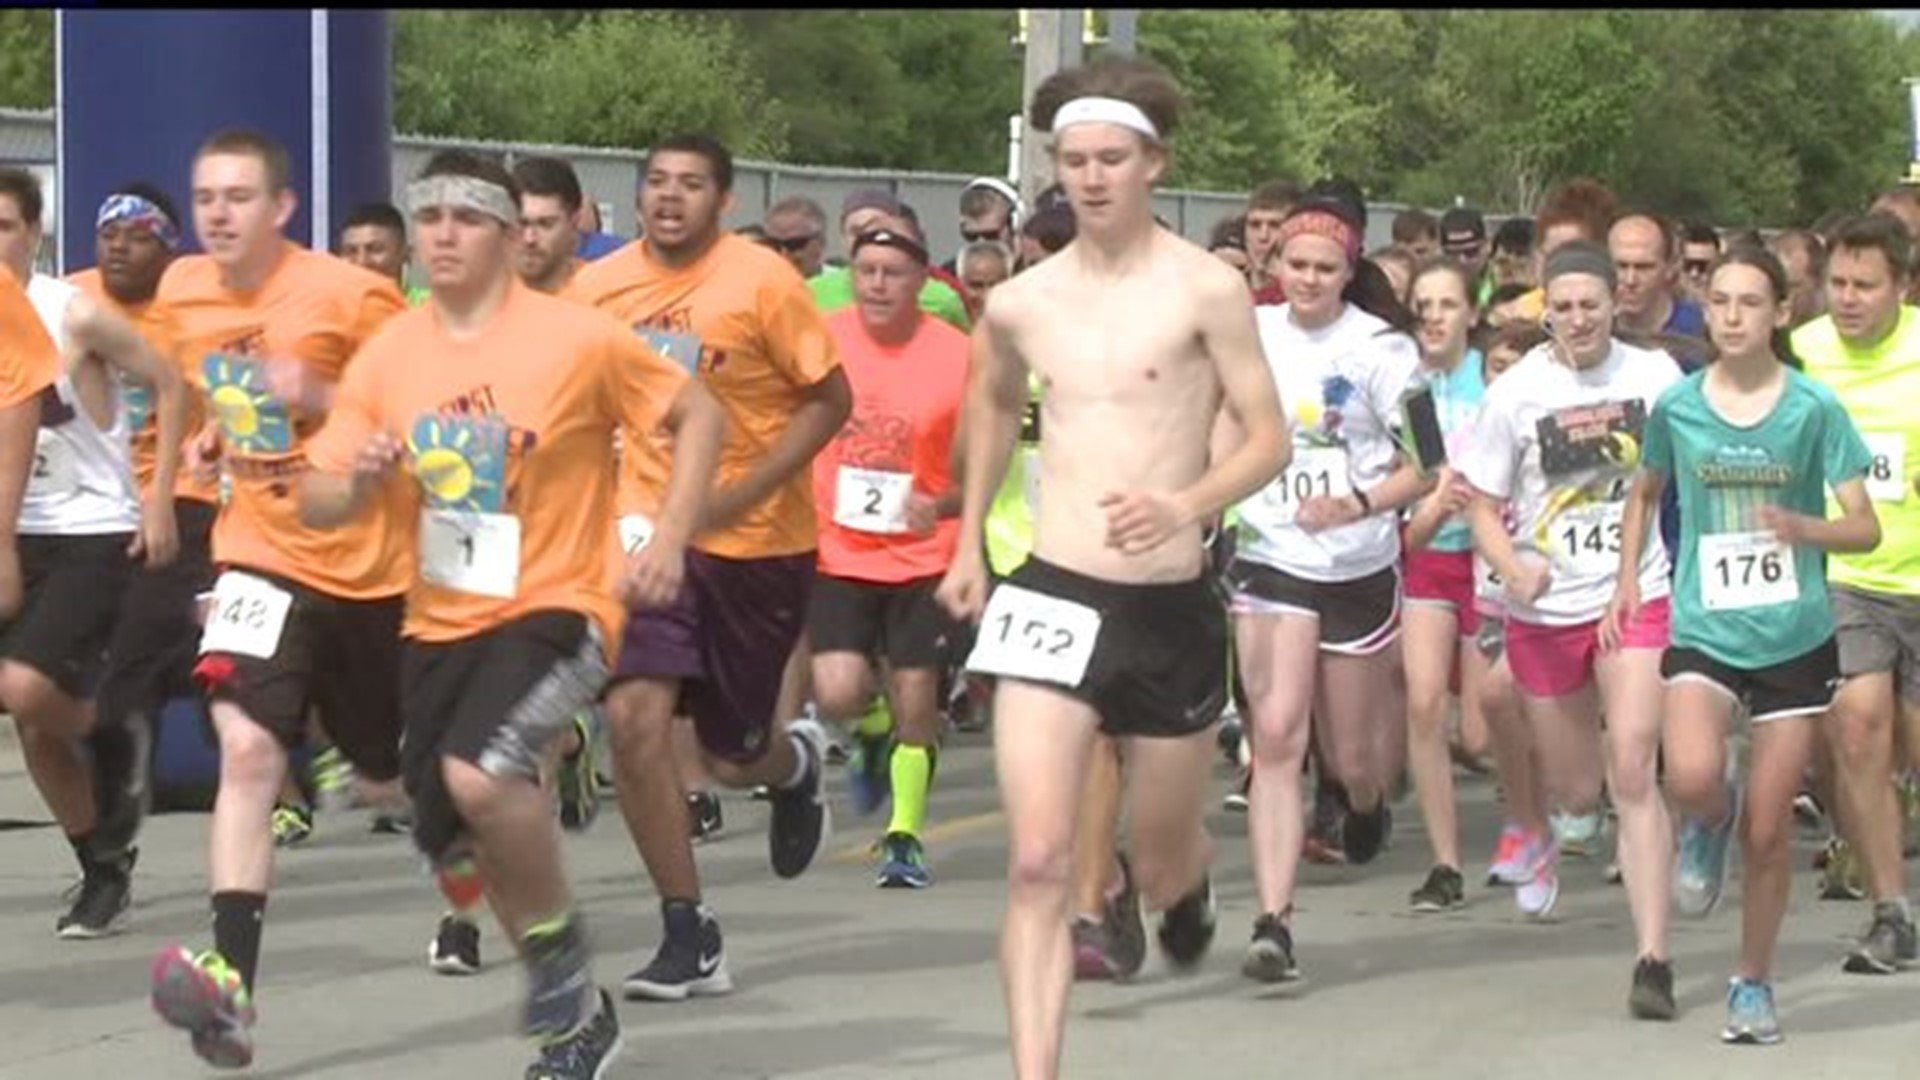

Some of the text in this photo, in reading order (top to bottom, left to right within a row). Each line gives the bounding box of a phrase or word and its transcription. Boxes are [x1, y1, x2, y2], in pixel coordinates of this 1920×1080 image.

[864, 487, 883, 515] 2
[1277, 469, 1331, 504] 101
[1563, 523, 1623, 557] 143
[1715, 551, 1783, 588] 176
[996, 612, 1075, 656] 152
